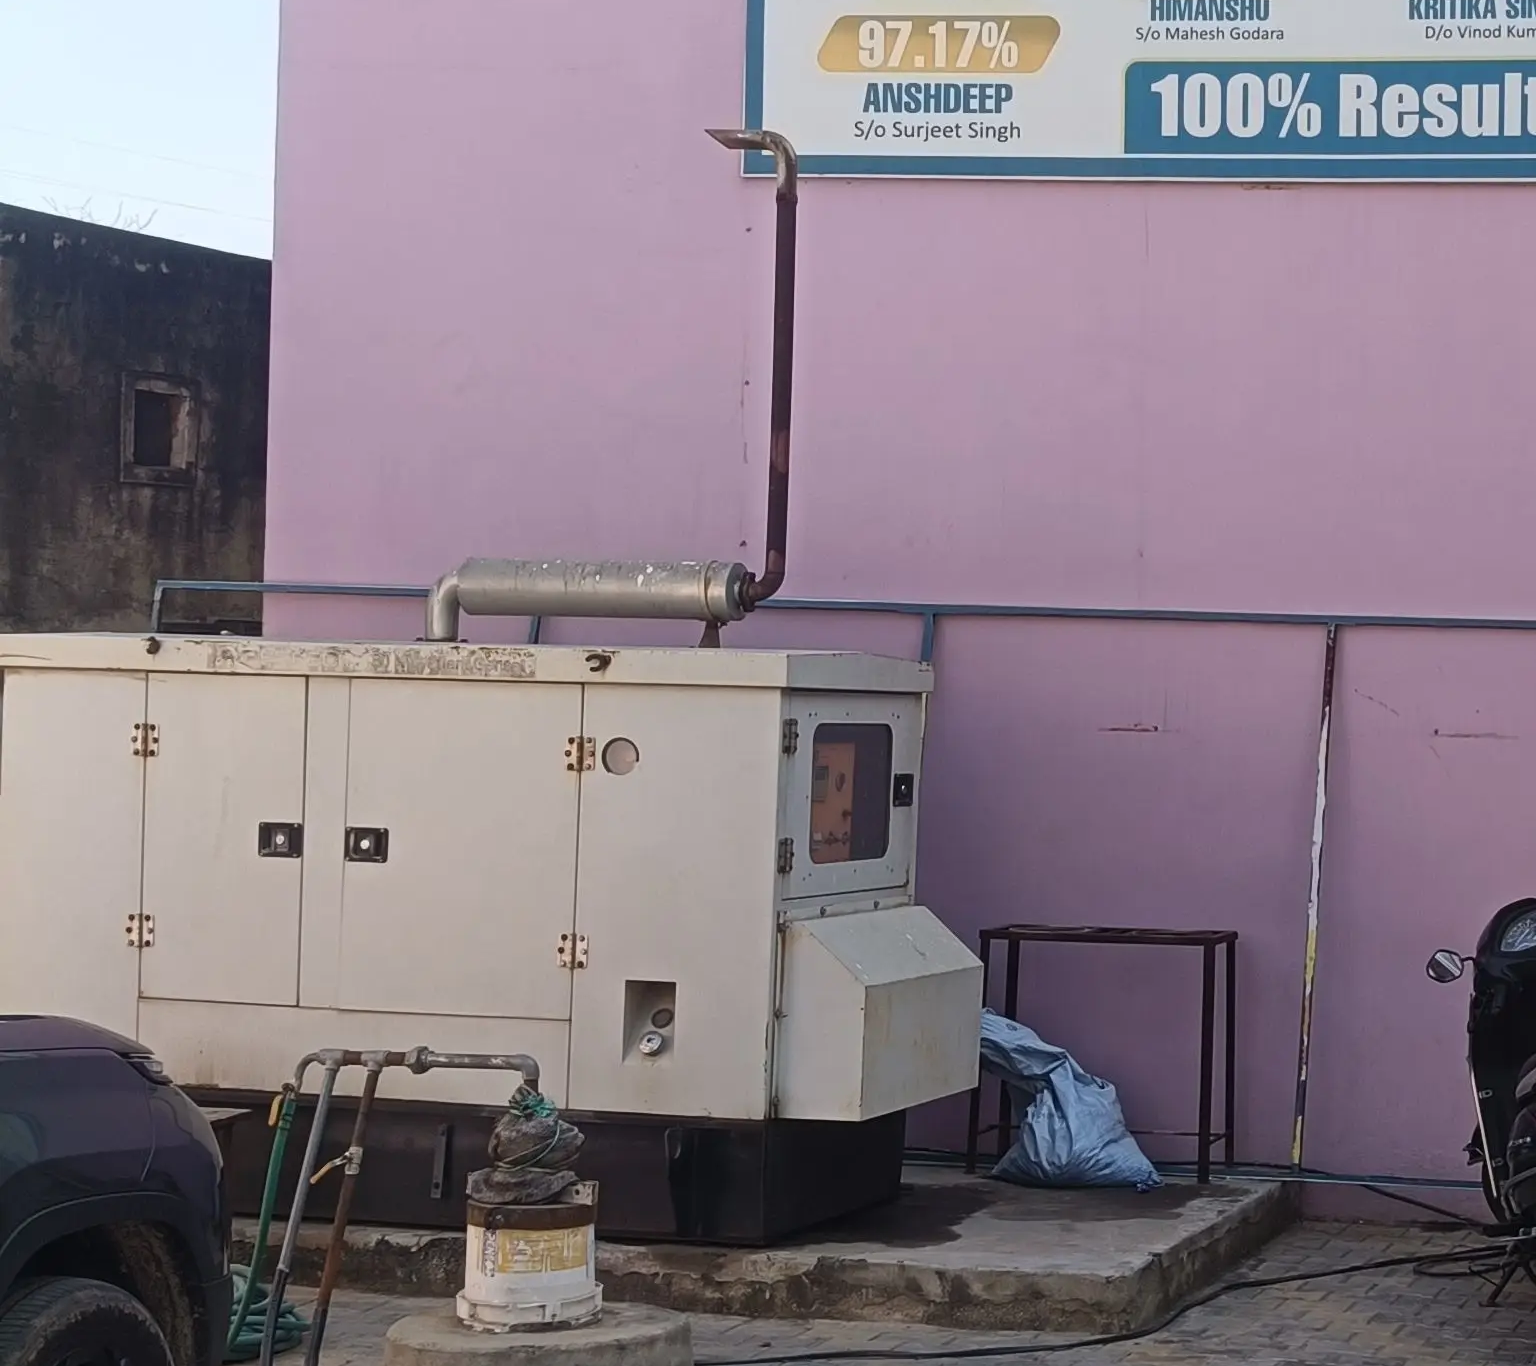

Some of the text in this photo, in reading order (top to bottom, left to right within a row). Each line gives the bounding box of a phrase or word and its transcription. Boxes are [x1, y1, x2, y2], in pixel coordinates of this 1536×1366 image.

[858, 20, 1018, 69] 97.17%
[1135, 25, 1284, 42] S/o Mahesh Godara
[1424, 25, 1453, 42] D/o
[1456, 24, 1501, 40] Vinod
[863, 82, 1013, 113] ANSHDEEP
[1150, 72, 1322, 138] 100%
[854, 120, 1021, 142] S/o Surjeet Singh
